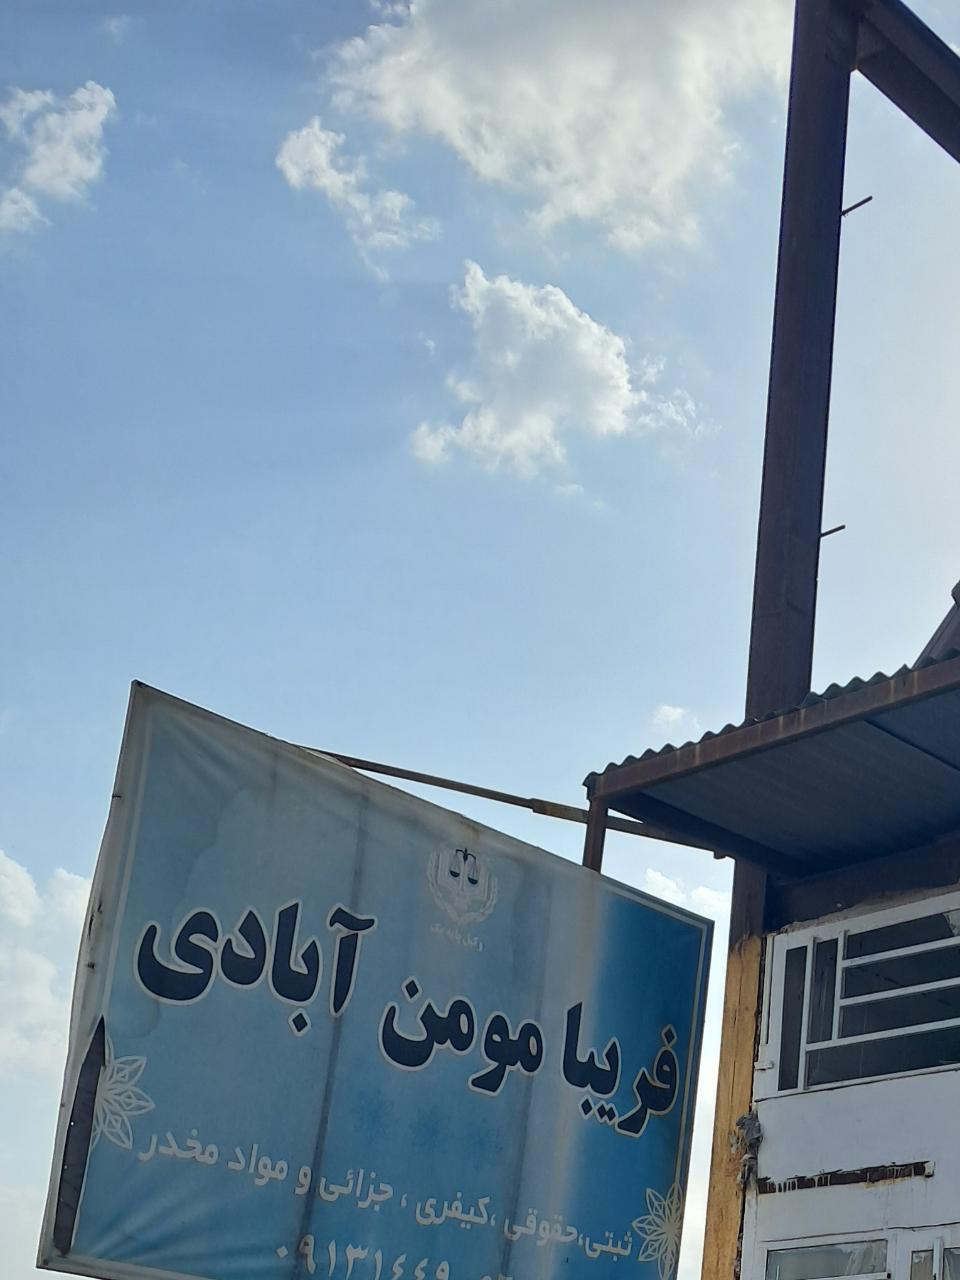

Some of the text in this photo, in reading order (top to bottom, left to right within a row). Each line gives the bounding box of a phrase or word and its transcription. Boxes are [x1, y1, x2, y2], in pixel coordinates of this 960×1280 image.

[136, 901, 680, 1136] فریبا مومن آبادی
[138, 1128, 220, 1165] مخدر
[227, 1143, 289, 1186] مواد
[294, 1164, 312, 1195] و
